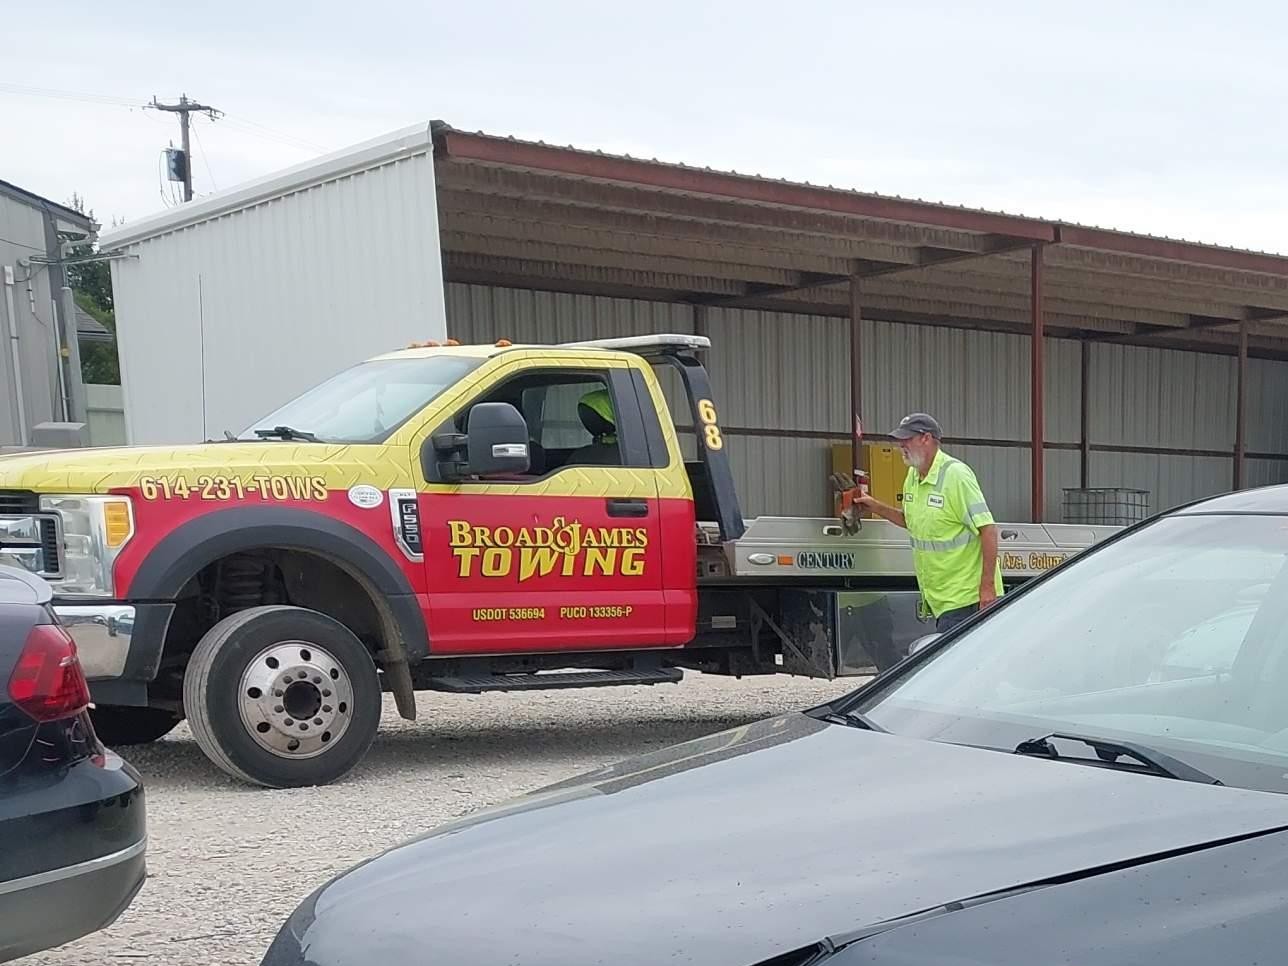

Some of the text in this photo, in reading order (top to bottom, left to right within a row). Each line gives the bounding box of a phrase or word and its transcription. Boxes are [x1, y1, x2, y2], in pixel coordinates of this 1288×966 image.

[698, 398, 723, 451] 68
[140, 475, 328, 501] 614-231-TOWS
[453, 547, 646, 582] TOWING
[797, 552, 856, 569] CENTURY
[473, 606, 633, 621] USDOT 536694 PUCO 133356-P
